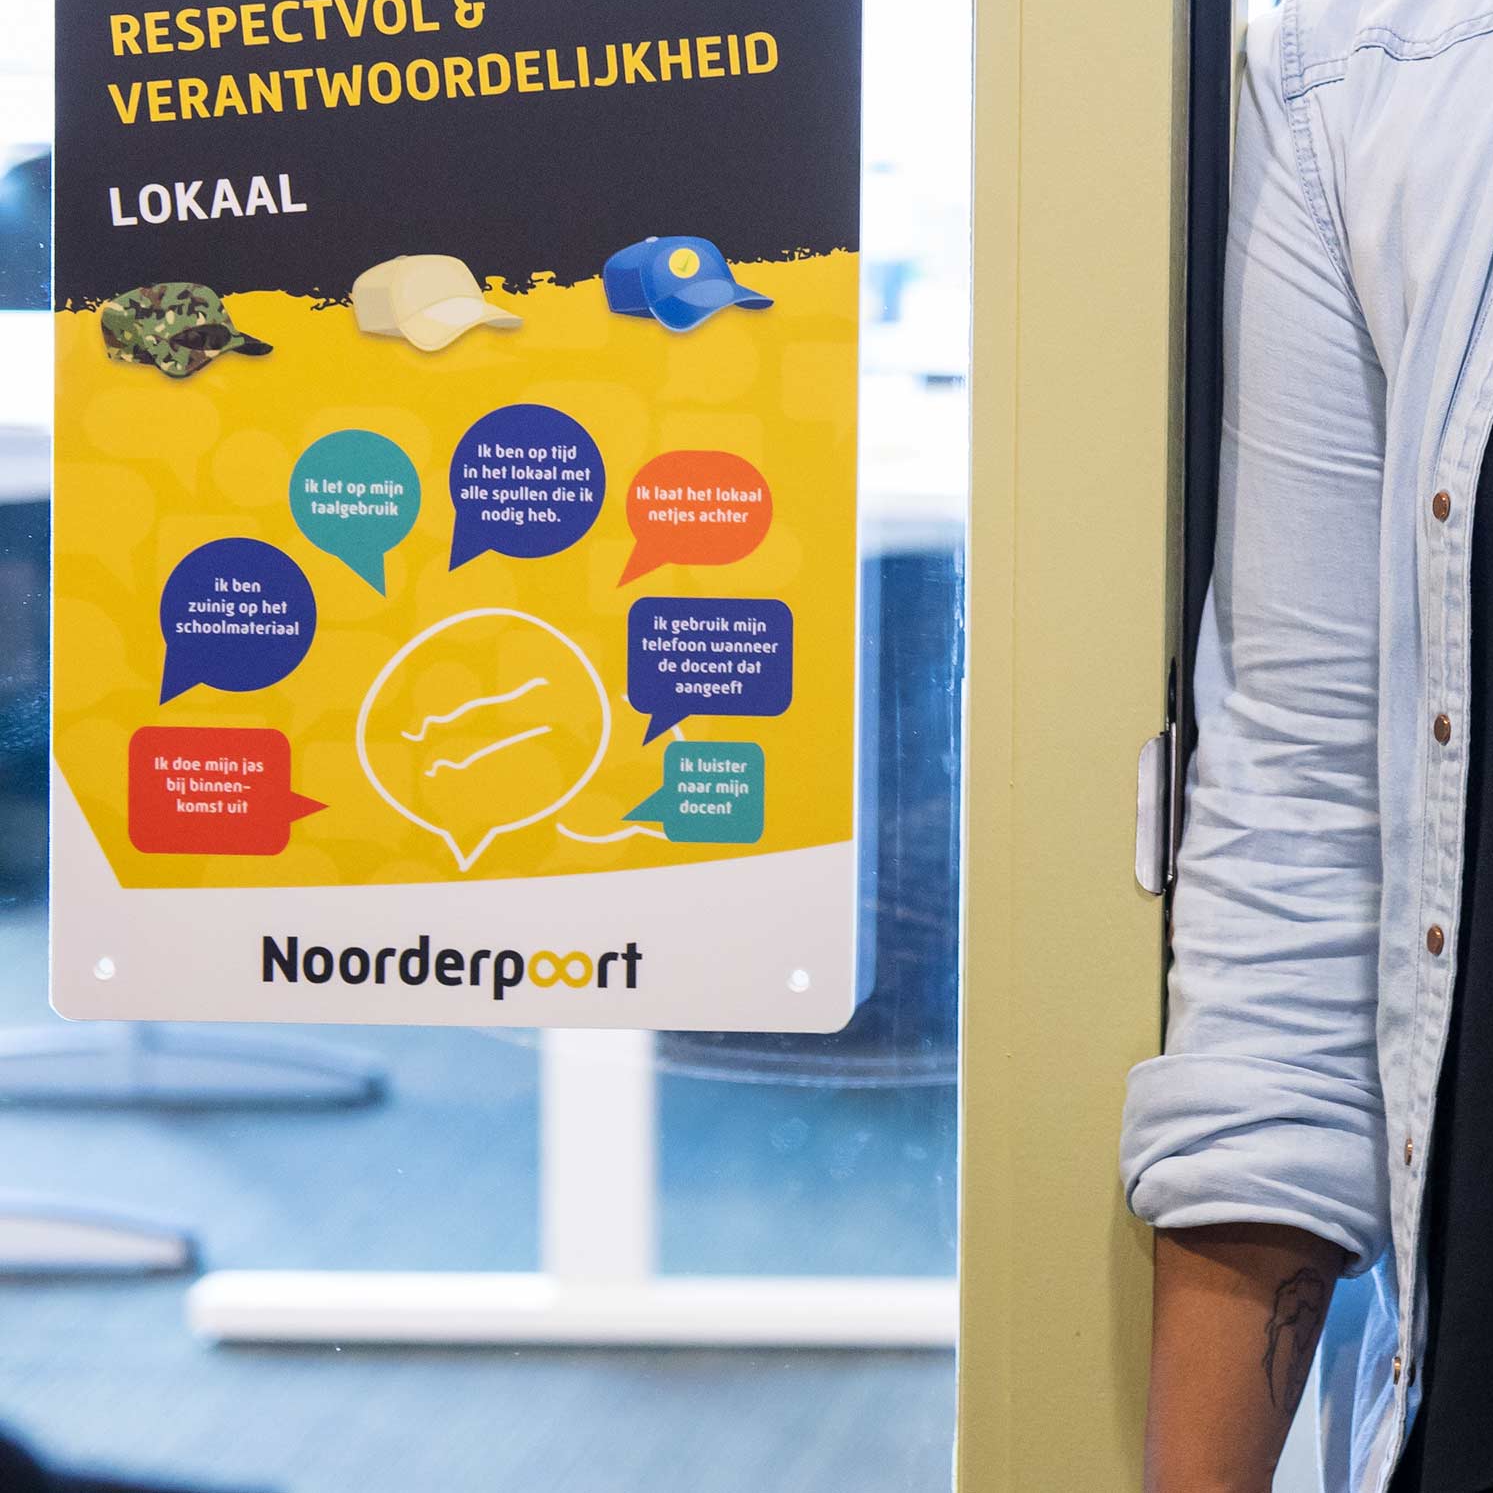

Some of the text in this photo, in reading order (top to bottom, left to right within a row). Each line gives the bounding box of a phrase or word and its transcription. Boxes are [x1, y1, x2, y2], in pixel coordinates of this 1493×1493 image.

[108, 31, 780, 125] VERANTWOORDELIJKHEID
[109, 173, 308, 227] LOKAAL
[477, 443, 577, 463] Ik ben op tijd
[463, 464, 591, 481] in het lokaal met
[304, 478, 404, 499] ik let op mijn
[460, 485, 593, 504] alle spullen die ik
[636, 485, 762, 502] Ik laat het lokaal
[311, 500, 399, 519] taalgebruik
[481, 507, 561, 525] nodig heb.
[648, 507, 749, 525] netjes achter
[214, 577, 261, 593] ik ben
[188, 599, 288, 617] zuinig op het
[175, 619, 300, 636] schoolmateriaal
[653, 616, 767, 636] ik gebruik mijn
[642, 637, 779, 654] telefoon wanneer
[658, 658, 762, 674] de docent dat
[675, 680, 743, 698] aangeeft
[154, 756, 264, 776] Ik doe mijn jas
[680, 757, 748, 773] ik luister
[166, 777, 251, 795] bij binnen-
[677, 779, 749, 798] naar mijn
[176, 798, 249, 814] komst uit
[679, 799, 732, 815] docent
[261, 934, 643, 1000] Noorderpoort
